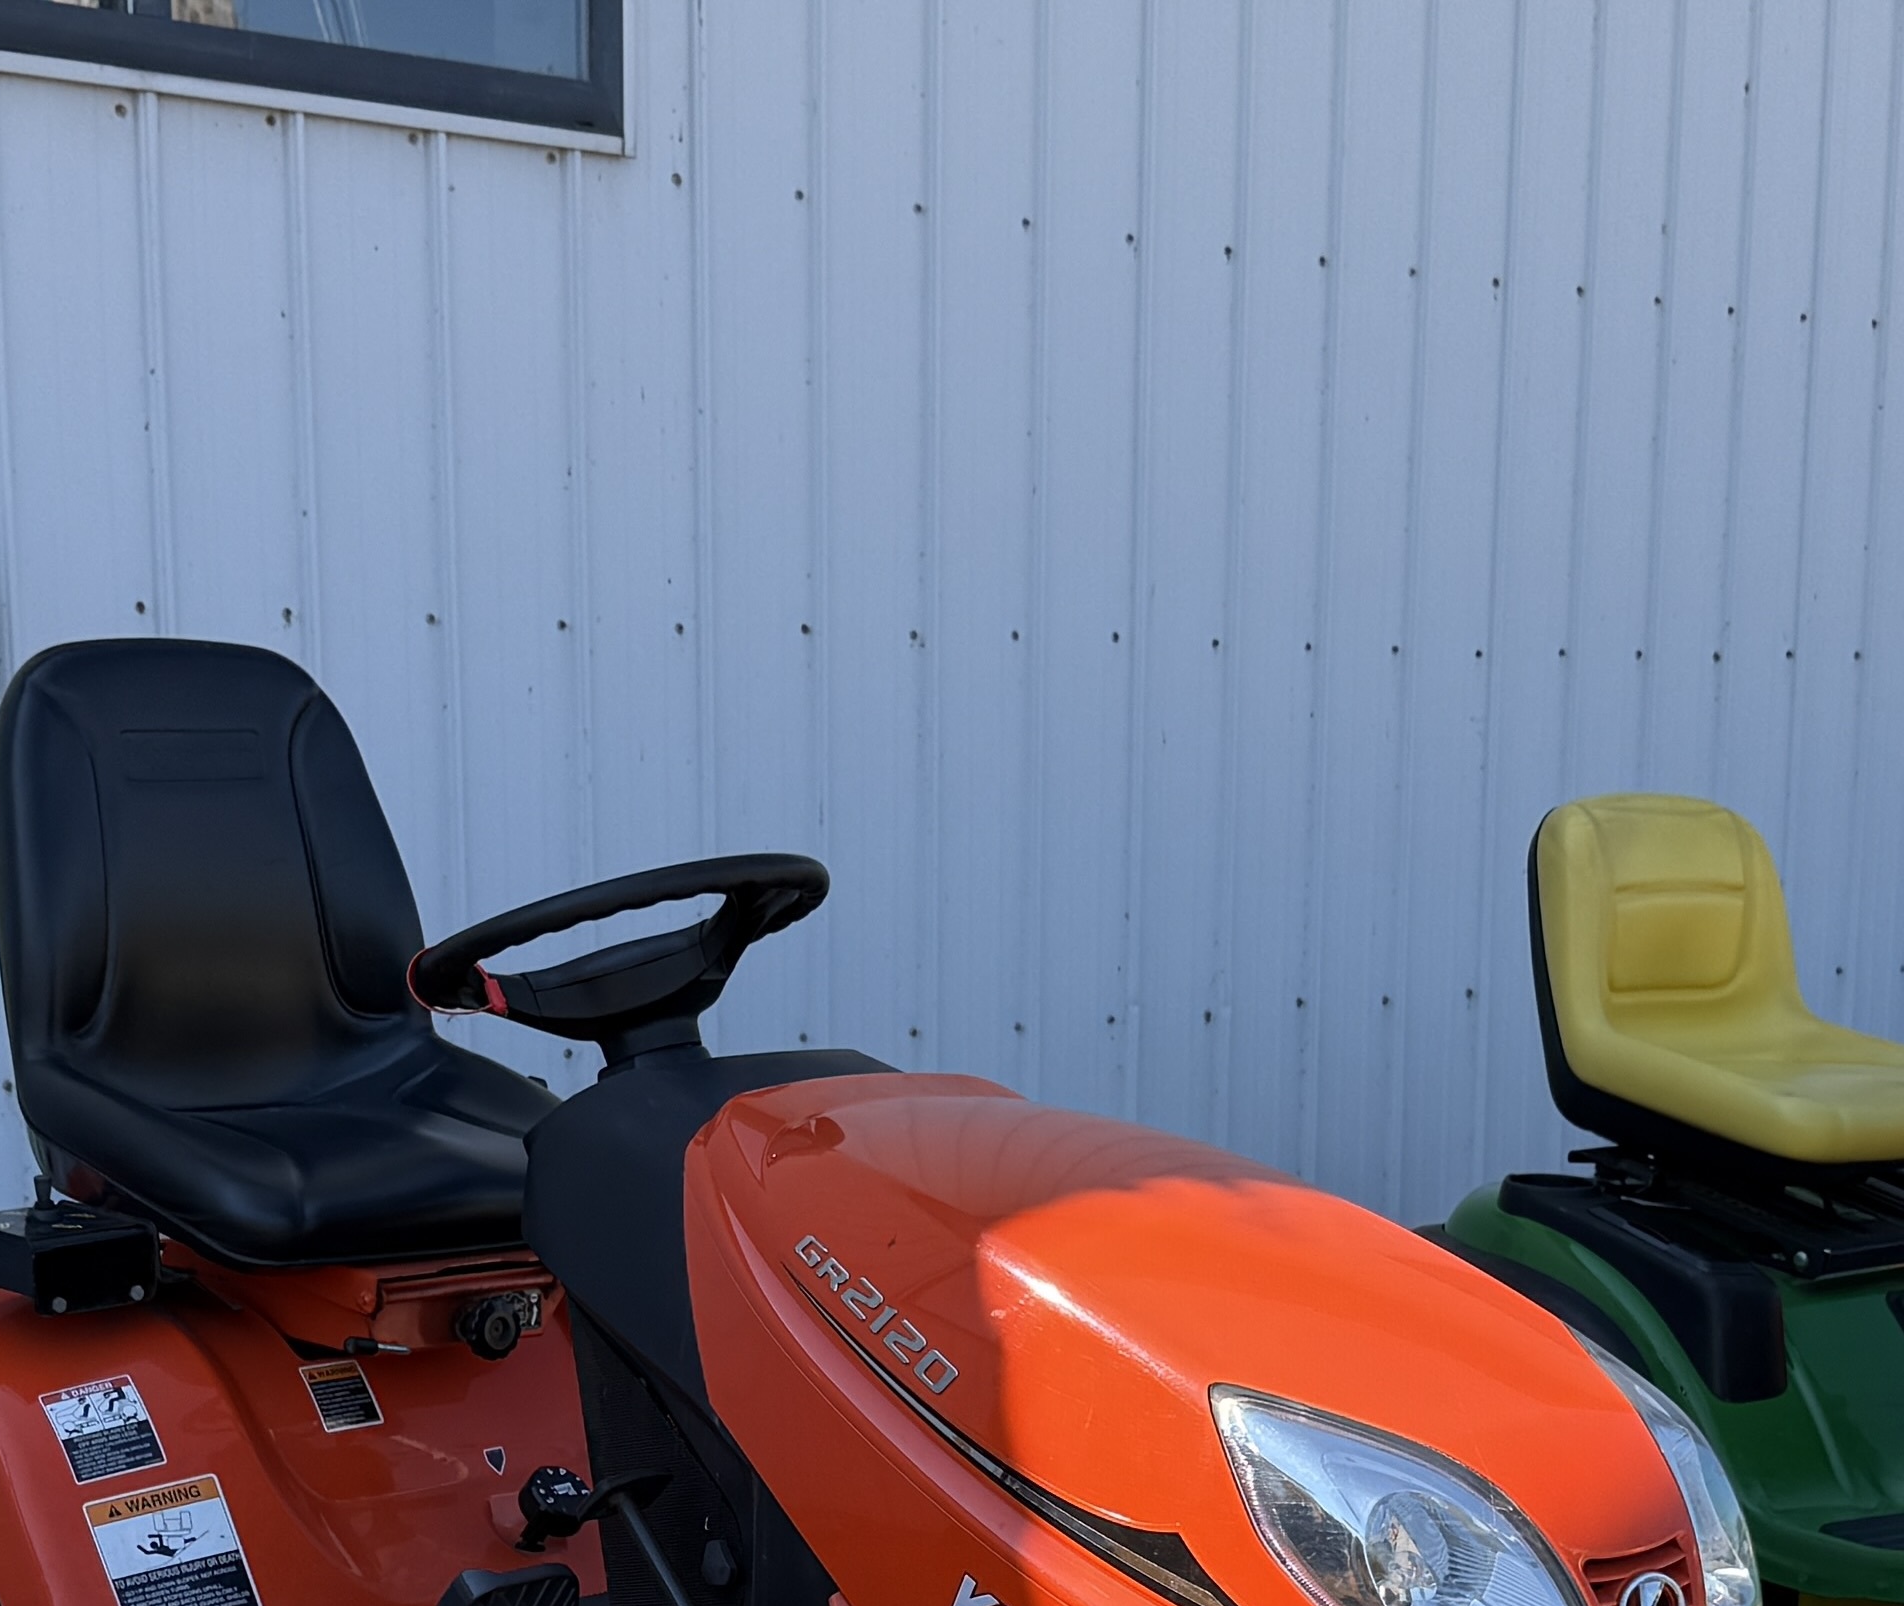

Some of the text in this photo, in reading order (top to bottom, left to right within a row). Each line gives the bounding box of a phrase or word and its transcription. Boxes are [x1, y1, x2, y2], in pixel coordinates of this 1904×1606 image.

[795, 1235, 959, 1394] GR2120
[125, 1485, 201, 1513] WARNING
[114, 1579, 125, 1589] TO
[124, 1574, 148, 1587] AVOID
[148, 1567, 180, 1581] SERIOUS
[180, 1561, 206, 1574] INJURY
[206, 1558, 218, 1568] OR
